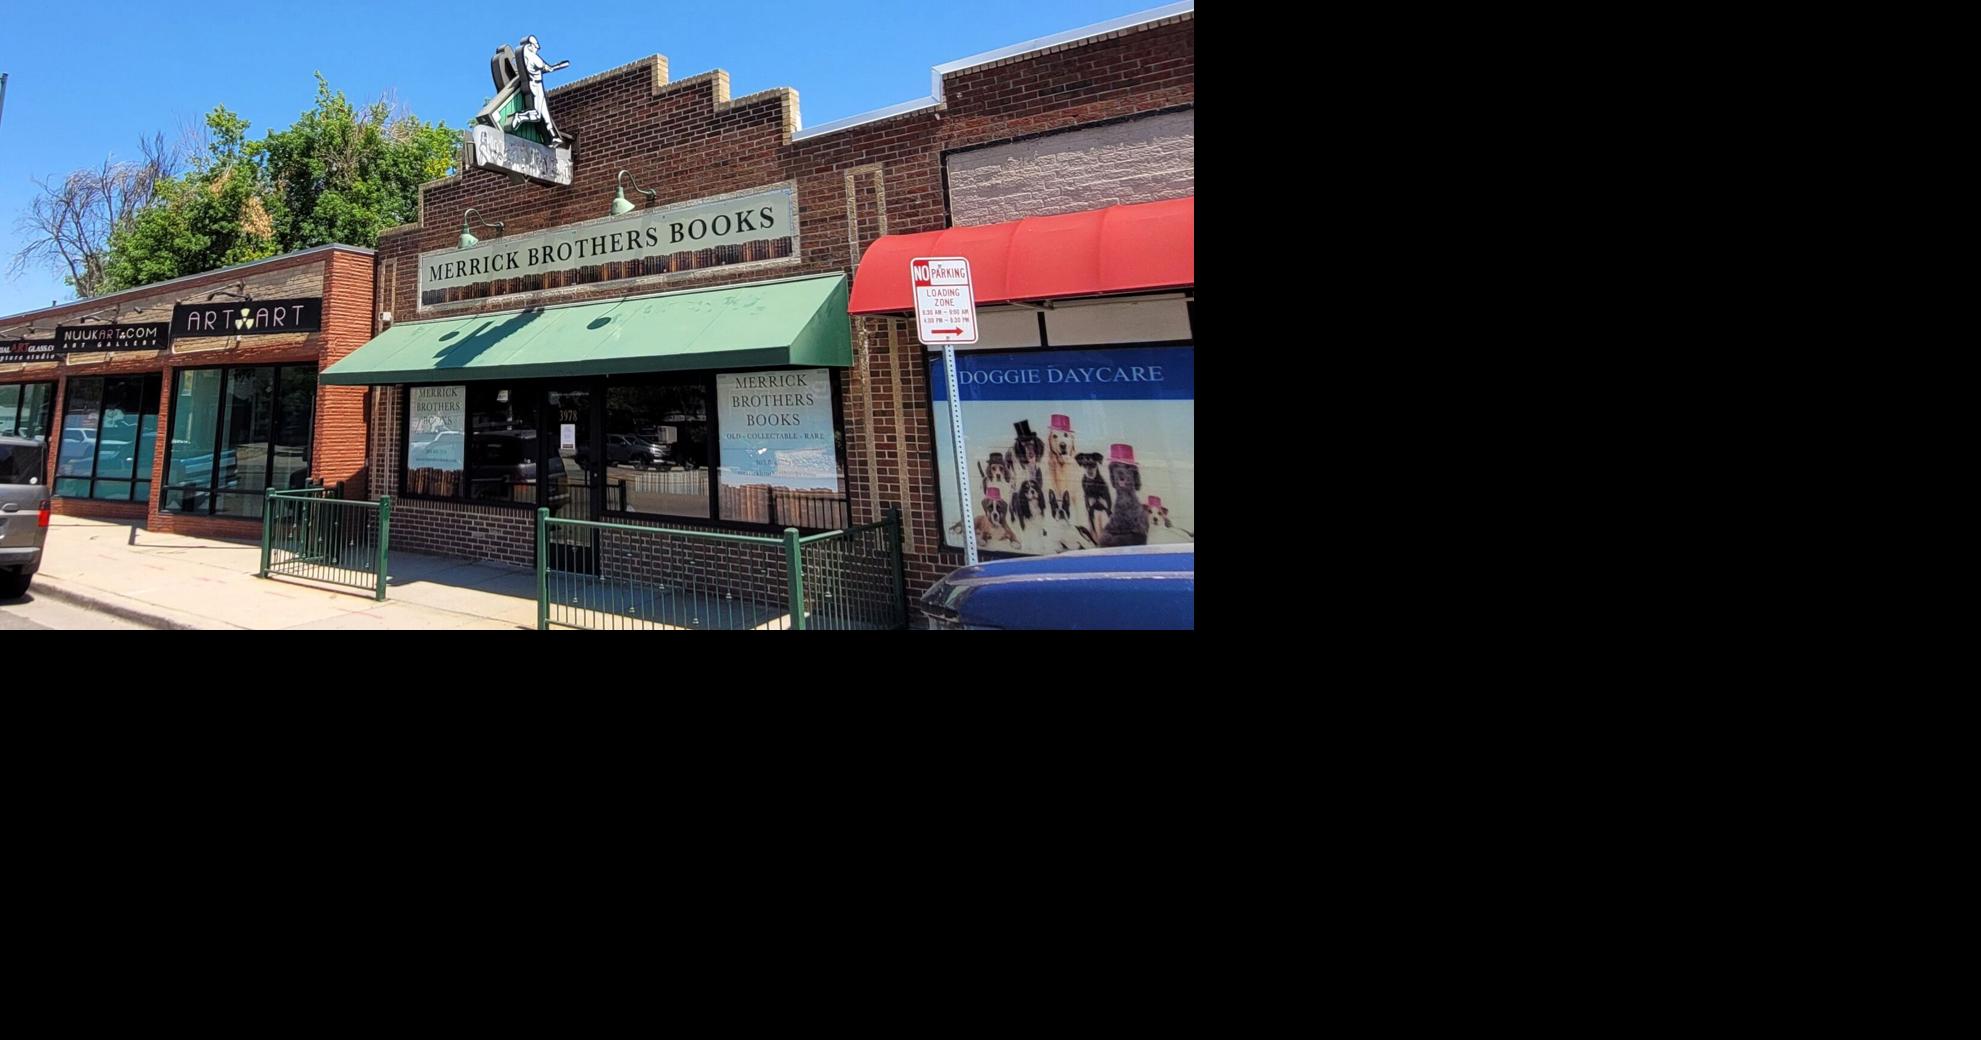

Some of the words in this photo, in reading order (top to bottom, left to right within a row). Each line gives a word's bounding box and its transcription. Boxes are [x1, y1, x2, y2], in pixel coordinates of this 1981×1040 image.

[429, 250, 520, 283] MERRICK
[528, 226, 658, 267] BROTHERS
[670, 206, 775, 244] BOOKS
[913, 264, 930, 282] NO
[931, 267, 966, 279] PARKING
[926, 288, 961, 297] LOADING
[934, 299, 955, 307] ZONE
[187, 309, 235, 331] ART
[255, 305, 305, 328] ART
[962, 316, 970, 324] PM
[735, 374, 808, 389] MERRICK
[959, 369, 1041, 385] DOGGIE
[1047, 366, 1164, 383] DAYCARE
[418, 387, 458, 398] MERRICK
[416, 401, 461, 412] BROTHERS
[732, 393, 815, 408] BROTHERS
[746, 413, 801, 426] BOOKS
[726, 432, 741, 440] OLD
[747, 432, 798, 440] COLLECTABLE
[804, 432, 825, 440] RARE
